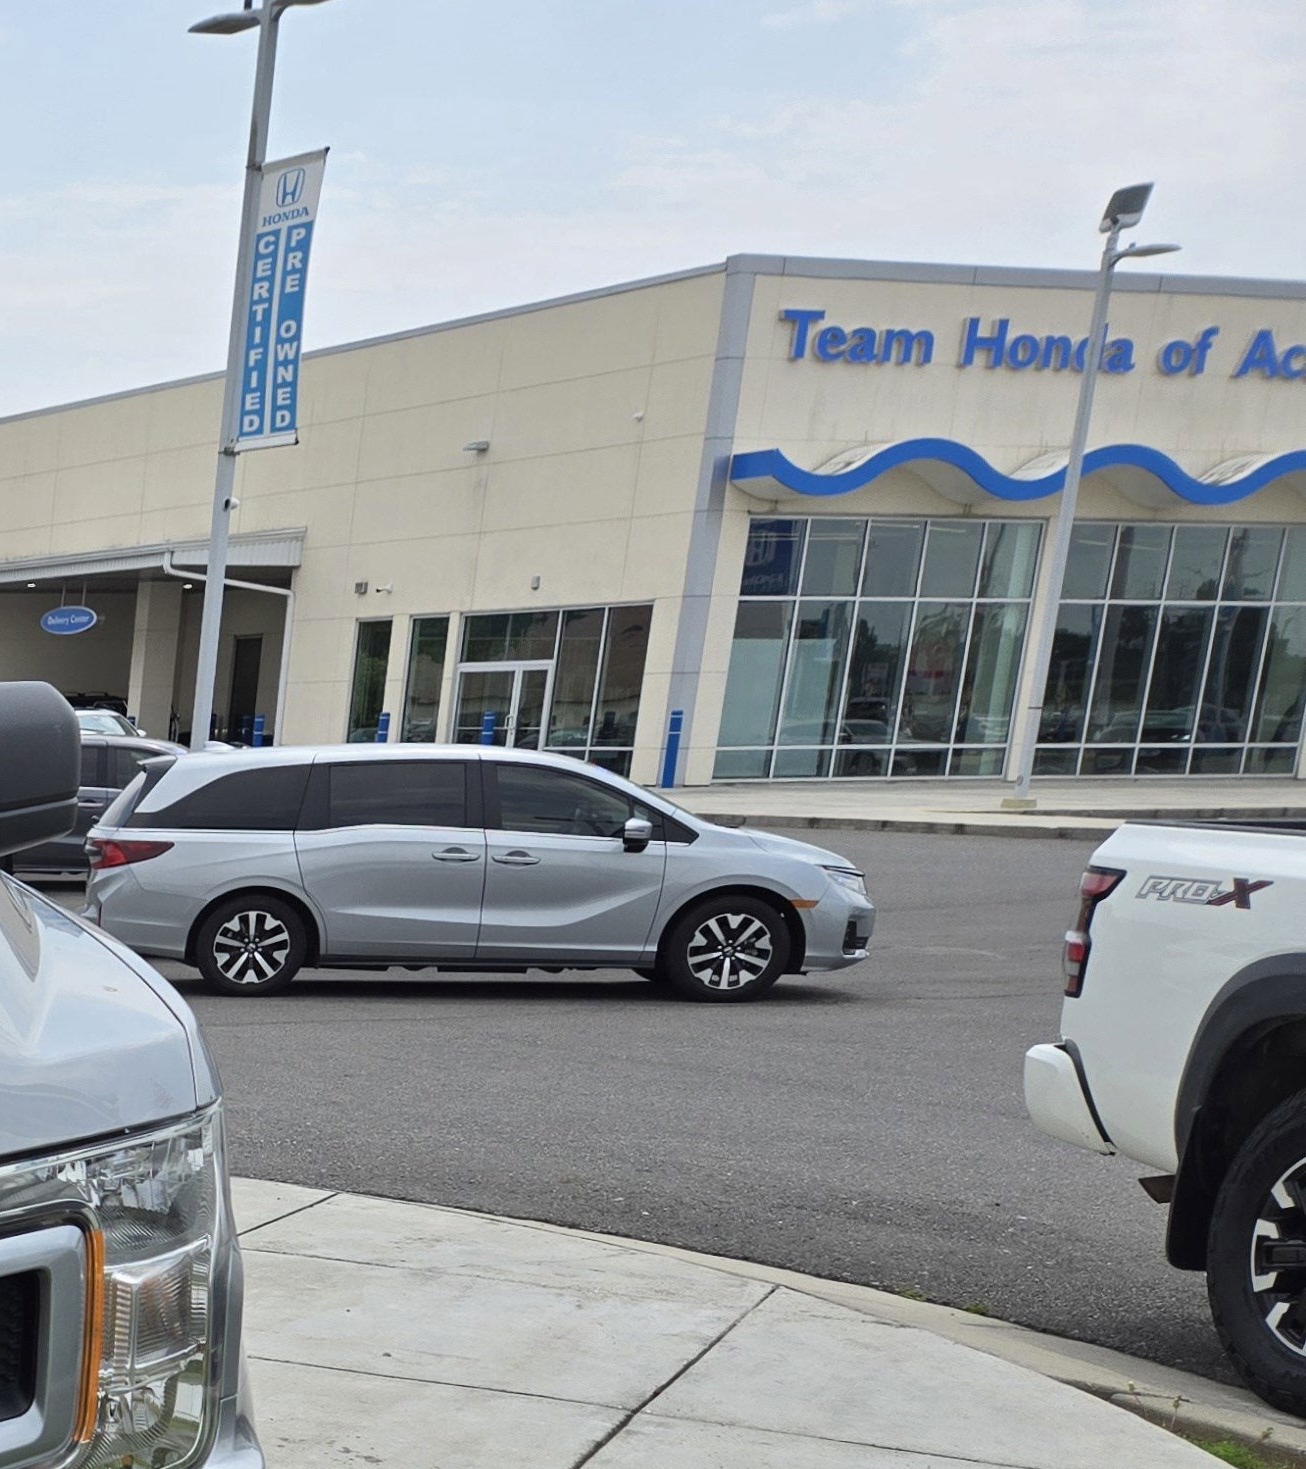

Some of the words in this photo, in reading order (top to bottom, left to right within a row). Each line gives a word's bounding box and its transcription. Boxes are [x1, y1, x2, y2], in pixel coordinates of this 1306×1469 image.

[263, 206, 309, 228] HONDA
[285, 227, 307, 293] PRE
[242, 234, 277, 434] CERTIFIED
[780, 308, 935, 367] Team
[1157, 326, 1220, 377] of
[275, 319, 299, 429] OWNED
